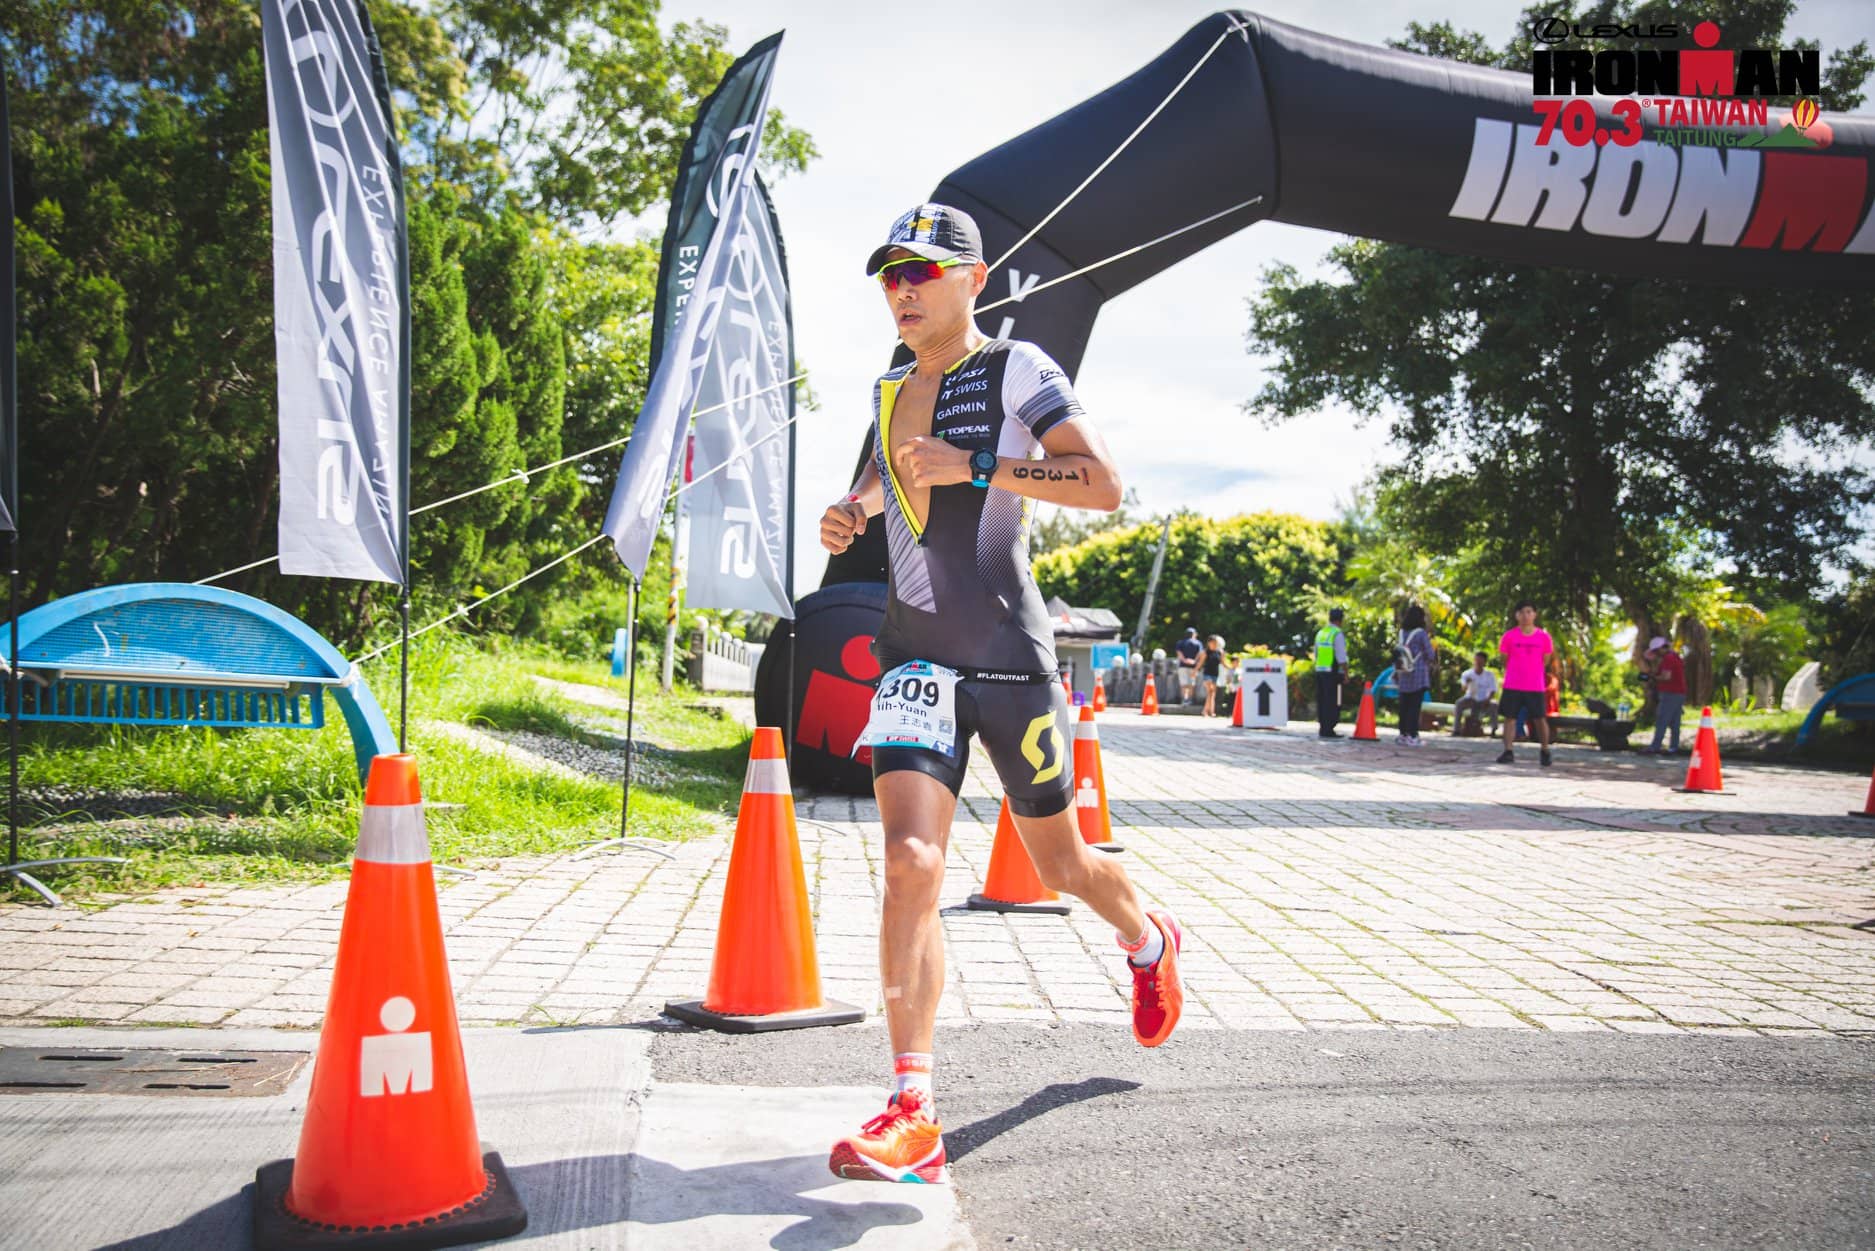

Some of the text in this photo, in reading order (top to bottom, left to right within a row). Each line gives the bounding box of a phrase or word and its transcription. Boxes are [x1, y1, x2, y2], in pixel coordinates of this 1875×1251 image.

[1448, 117, 1875, 254] IRONM
[674, 245, 699, 325] EXPE
[955, 380, 988, 396] SWISS
[937, 401, 987, 420] GARMIN
[948, 424, 990, 436] TOPEAK
[976, 672, 1030, 682] #FLATOUTFAST
